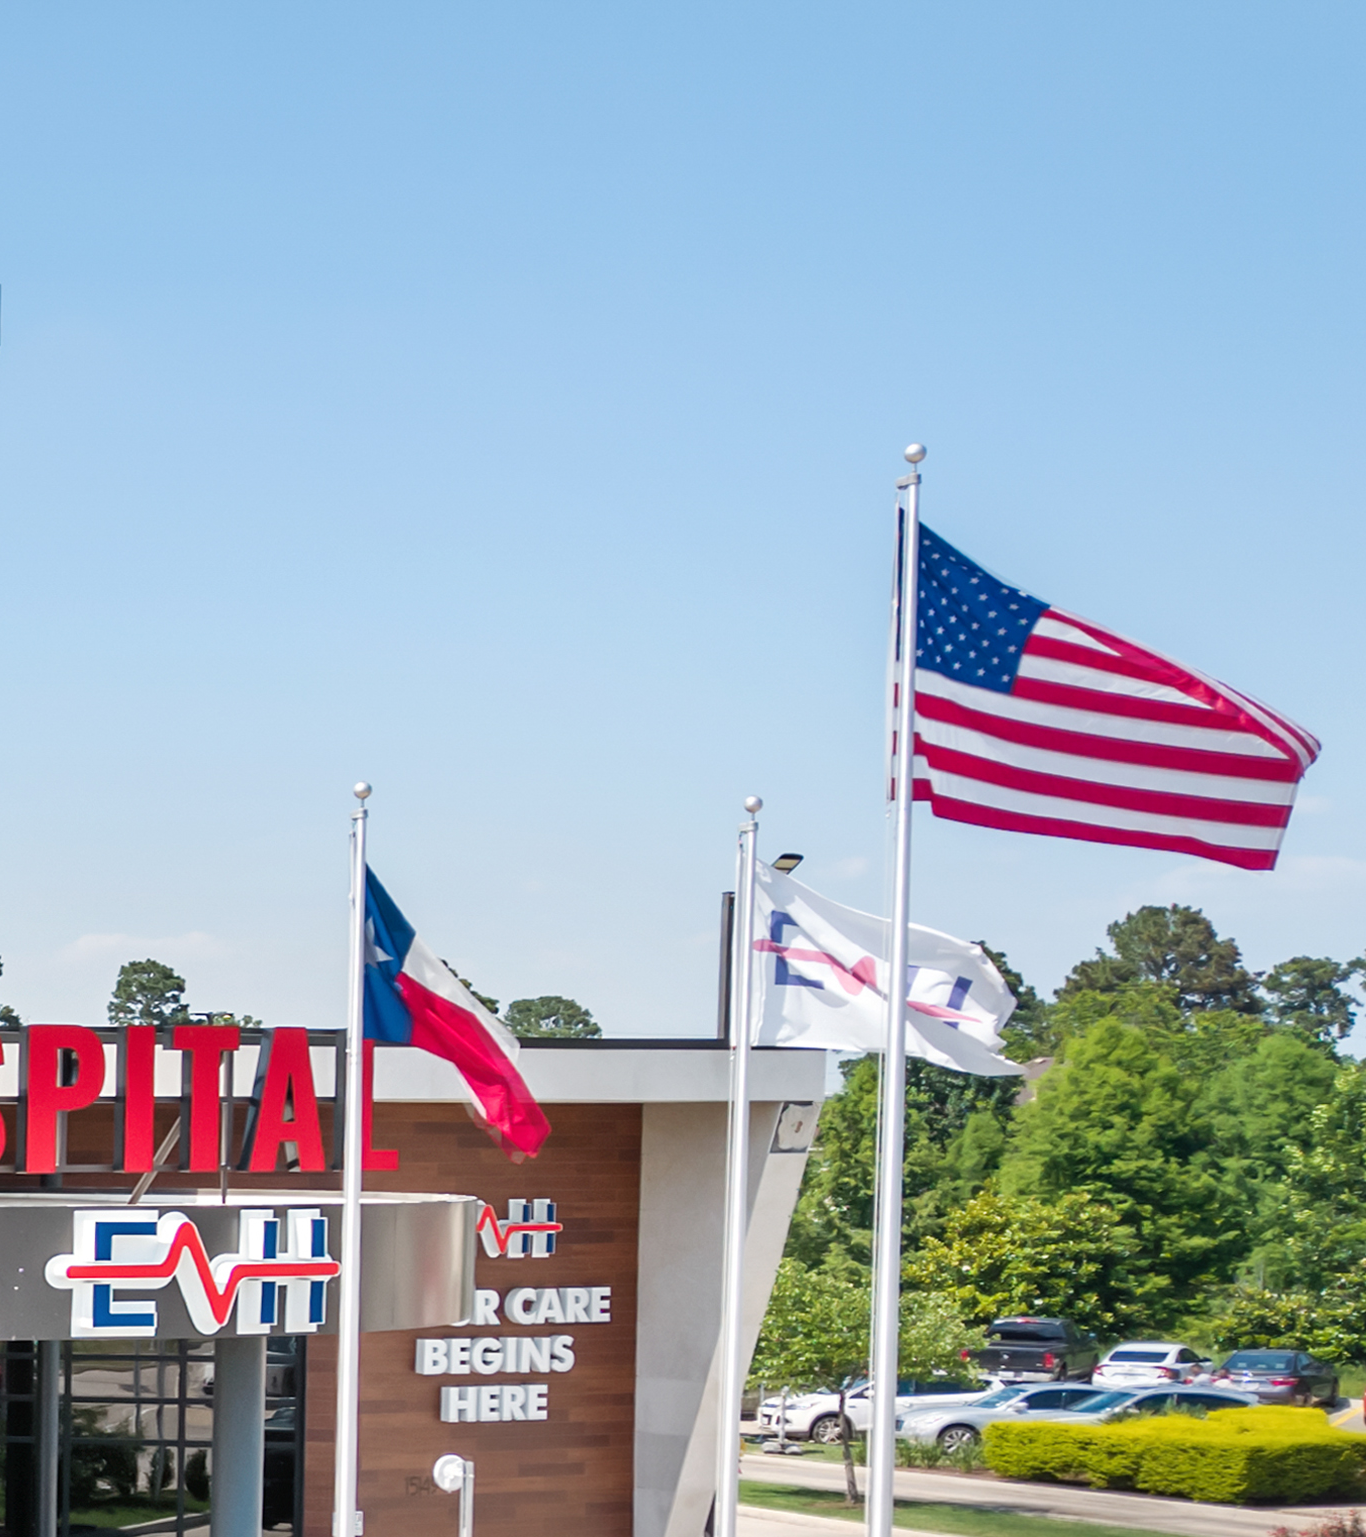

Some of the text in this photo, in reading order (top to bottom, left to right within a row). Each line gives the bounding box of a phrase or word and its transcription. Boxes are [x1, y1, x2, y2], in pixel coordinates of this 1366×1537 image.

[504, 1287, 611, 1325] CARE
[417, 1336, 575, 1375] BEGINS
[441, 1384, 548, 1423] HERE
